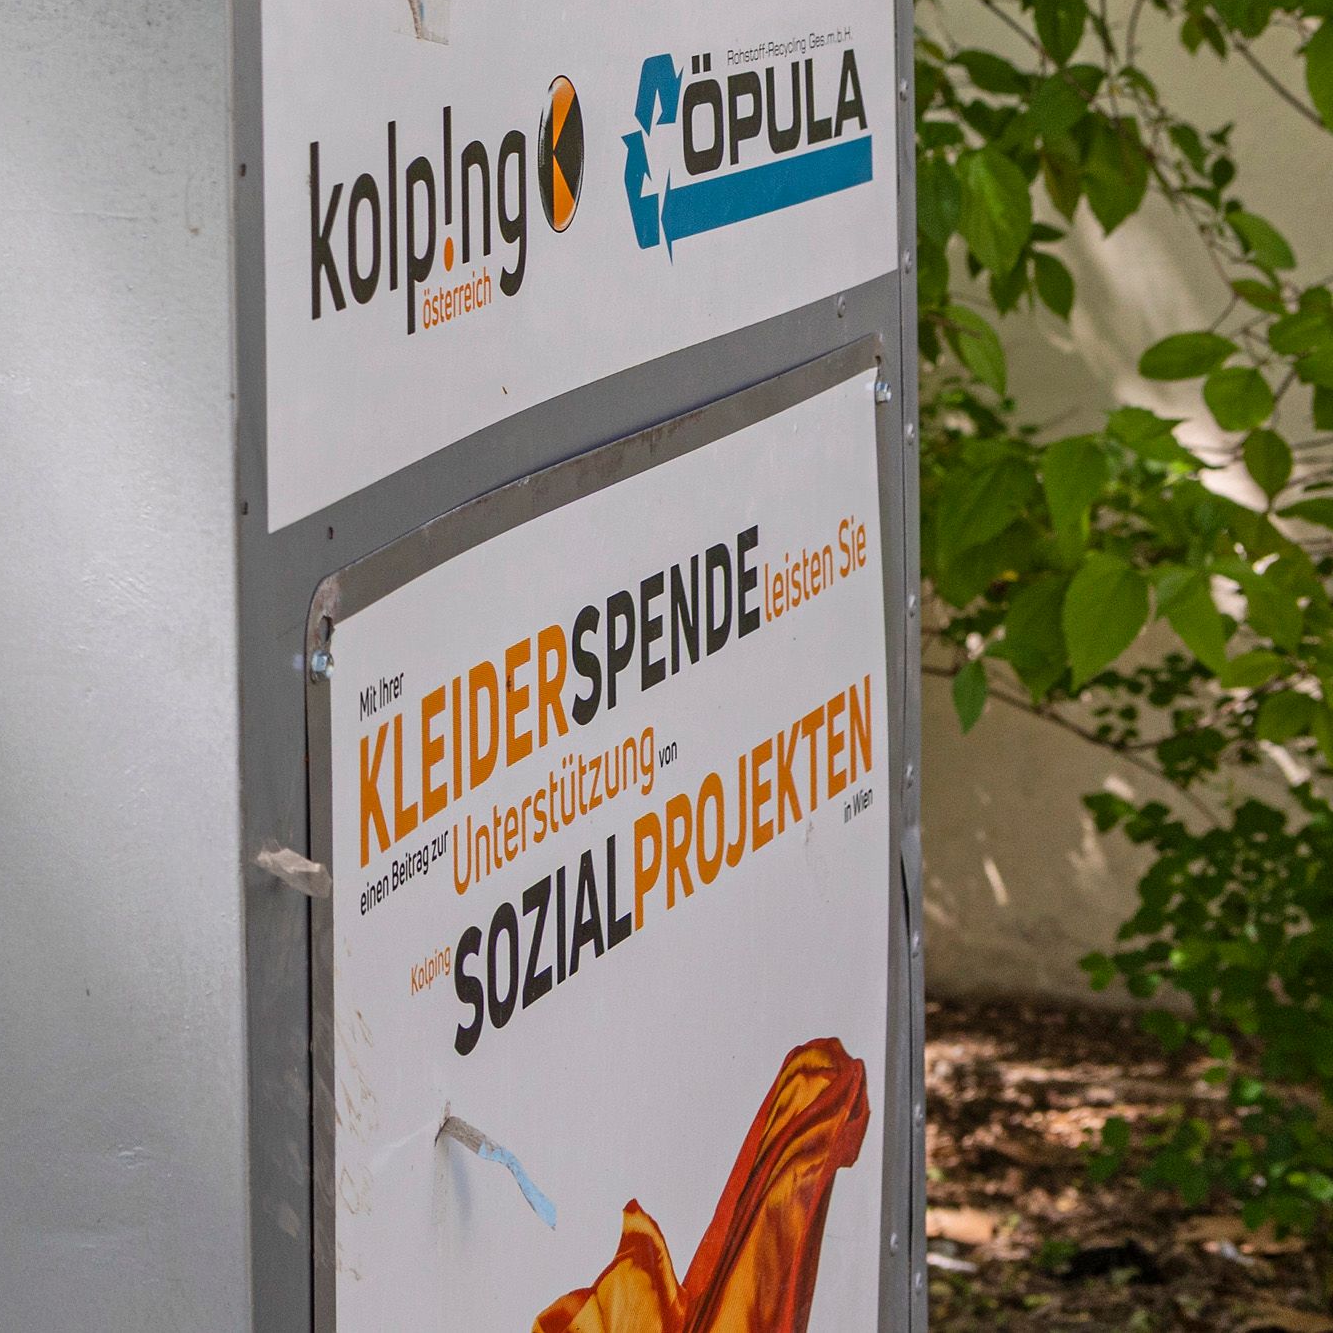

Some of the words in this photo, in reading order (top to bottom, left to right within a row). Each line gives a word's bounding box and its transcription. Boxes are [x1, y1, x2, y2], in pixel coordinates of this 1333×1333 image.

[727, 37, 806, 65] Rohstoff-Recycling
[682, 49, 868, 176] ÖPULA
[423, 268, 492, 330] österreich
[359, 524, 761, 869] KLEIDERSPENDE
[765, 548, 834, 622] leisten
[838, 514, 866, 578] Sie
[359, 686, 377, 721] Mit
[379, 672, 404, 708] Ihrer
[360, 874, 389, 915] einen
[391, 844, 429, 892] Beitrag
[431, 830, 449, 862] zur
[452, 726, 655, 895] Unterstützung
[658, 741, 678, 768] von
[844, 798, 851, 824] in
[852, 787, 874, 817] Wien
[410, 946, 451, 996] Kolping
[453, 674, 873, 1056] SOZIALPROJEKTEN
